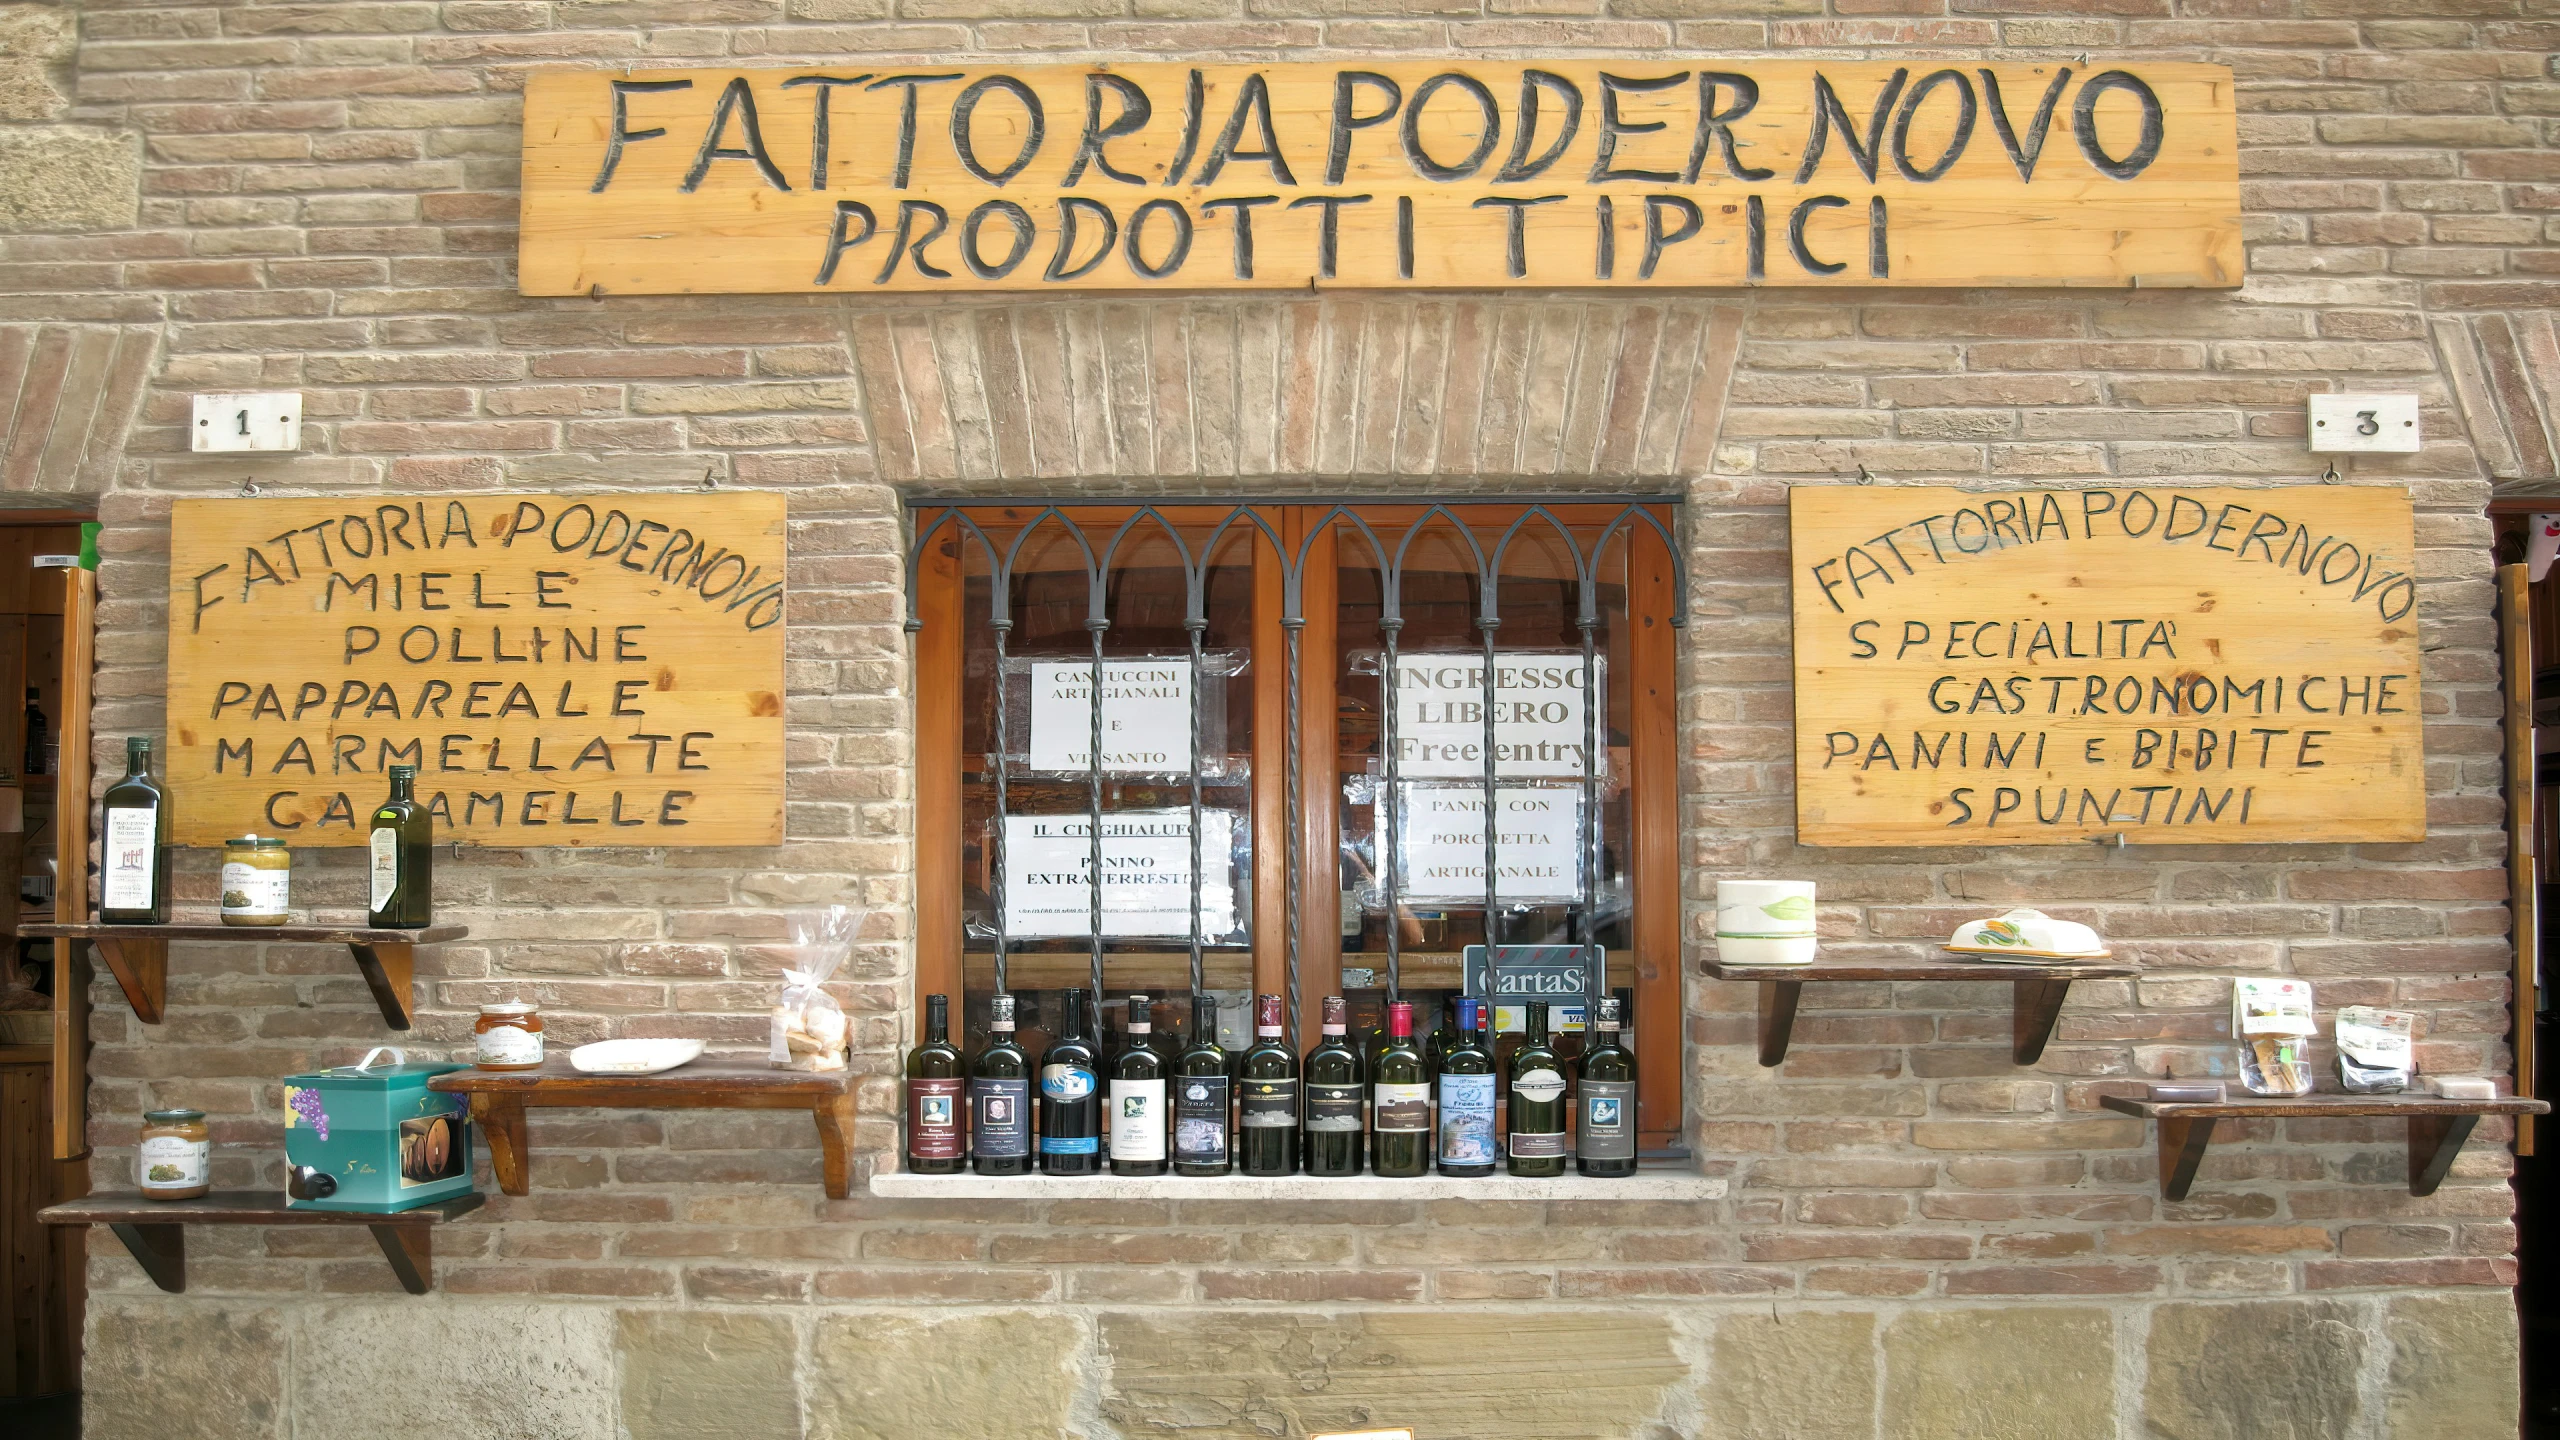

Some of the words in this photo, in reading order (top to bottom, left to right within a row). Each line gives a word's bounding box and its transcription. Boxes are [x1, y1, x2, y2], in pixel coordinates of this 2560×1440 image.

[590, 68, 1298, 193] FATTORIA
[814, 194, 1415, 286] PRODOTTI
[1472, 194, 1889, 281] TIPICI
[236, 410, 250, 435] 1
[2356, 410, 2379, 435] 3
[193, 500, 477, 634] FATTORIA
[502, 501, 785, 633] PODERNOVO
[1811, 492, 2069, 613] FATTORIA
[2082, 490, 2416, 624] PODERNOVO
[323, 571, 573, 612] MIELE
[343, 625, 648, 667] POLLINE
[1395, 666, 1585, 690] INGRESSO
[1051, 687, 1181, 699] ARTGIANALI
[1926, 675, 2408, 716] GASTRONOMICHE
[1417, 700, 1570, 724] LIBERO
[1112, 720, 1122, 731] E
[214, 732, 715, 777] MARMELLATE
[1068, 753, 1095, 764] VI
[1102, 752, 1167, 764] SANTO
[1396, 737, 1479, 762] Free
[1494, 738, 1586, 769] entry
[1823, 731, 2047, 771] PANINI
[2132, 729, 2332, 772] BIBITE
[265, 790, 696, 830] CAAMELLE
[1432, 800, 1498, 812] PANIN
[1509, 800, 1550, 812] CON
[1947, 786, 2256, 828] SPUNTINI
[1034, 824, 1052, 836] IL
[1432, 833, 1551, 845] PORCETTA
[1081, 856, 1155, 868] PNINO
[1423, 866, 1560, 878] ARTIGANALE
[1027, 872, 1209, 885] EXTRAERRESTE
